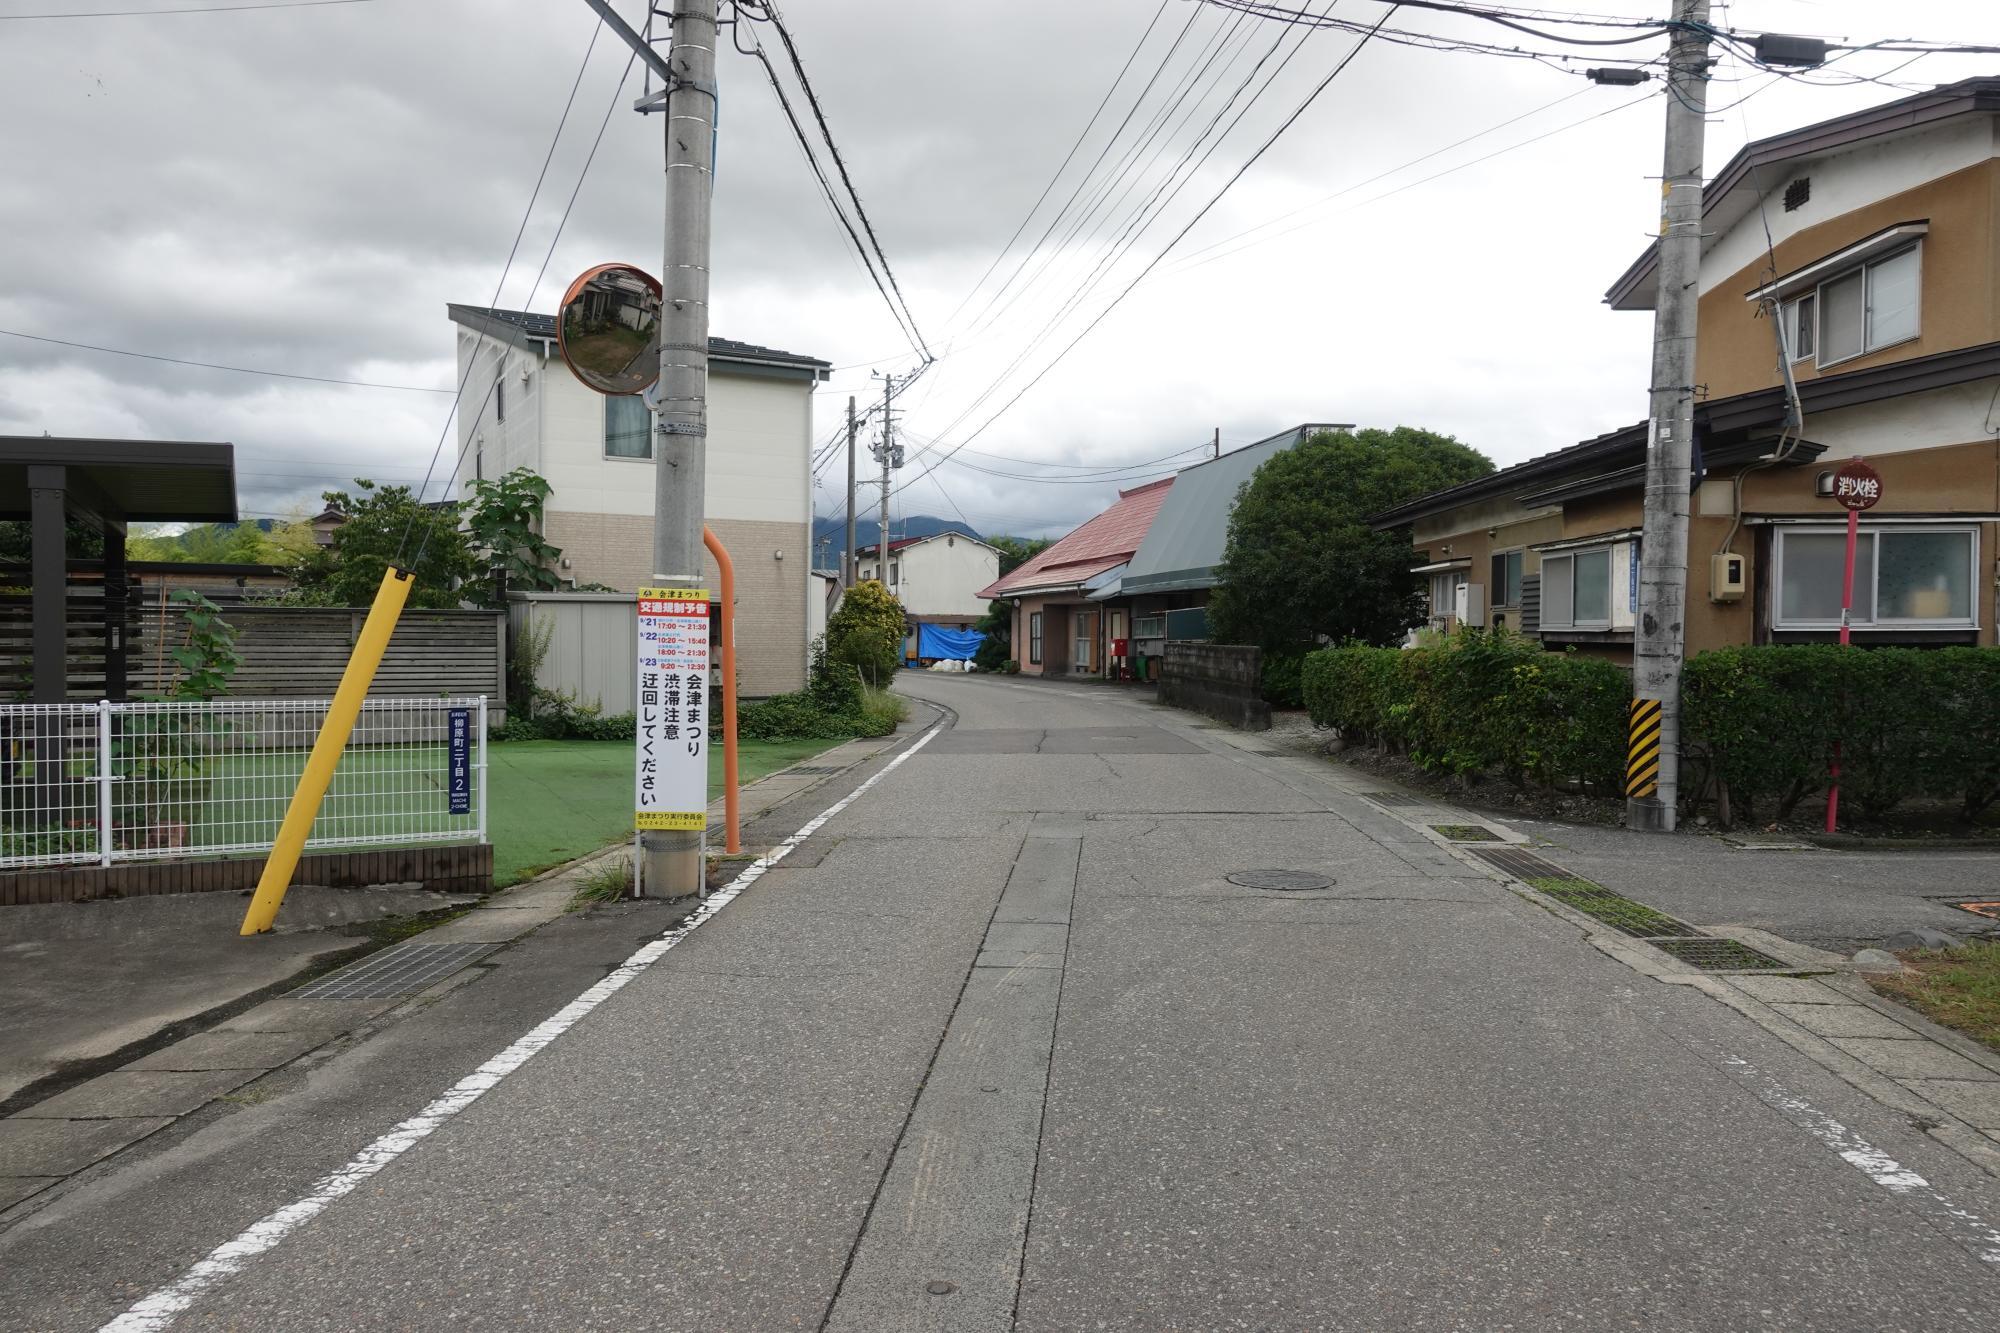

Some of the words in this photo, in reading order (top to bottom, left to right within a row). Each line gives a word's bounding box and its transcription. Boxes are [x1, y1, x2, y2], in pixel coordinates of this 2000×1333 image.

[1838, 476, 1879, 498] 消火栓
[660, 590, 700, 599] 会津まつり
[640, 601, 707, 614] 交通規制予告
[688, 637, 707, 645] 15:40
[657, 648, 676, 656] 18:00
[687, 649, 707, 657] 21:30
[664, 673, 680, 740] 渋滞注意
[686, 673, 702, 757] 会津まつり
[640, 672, 659, 806] 迂回してください
